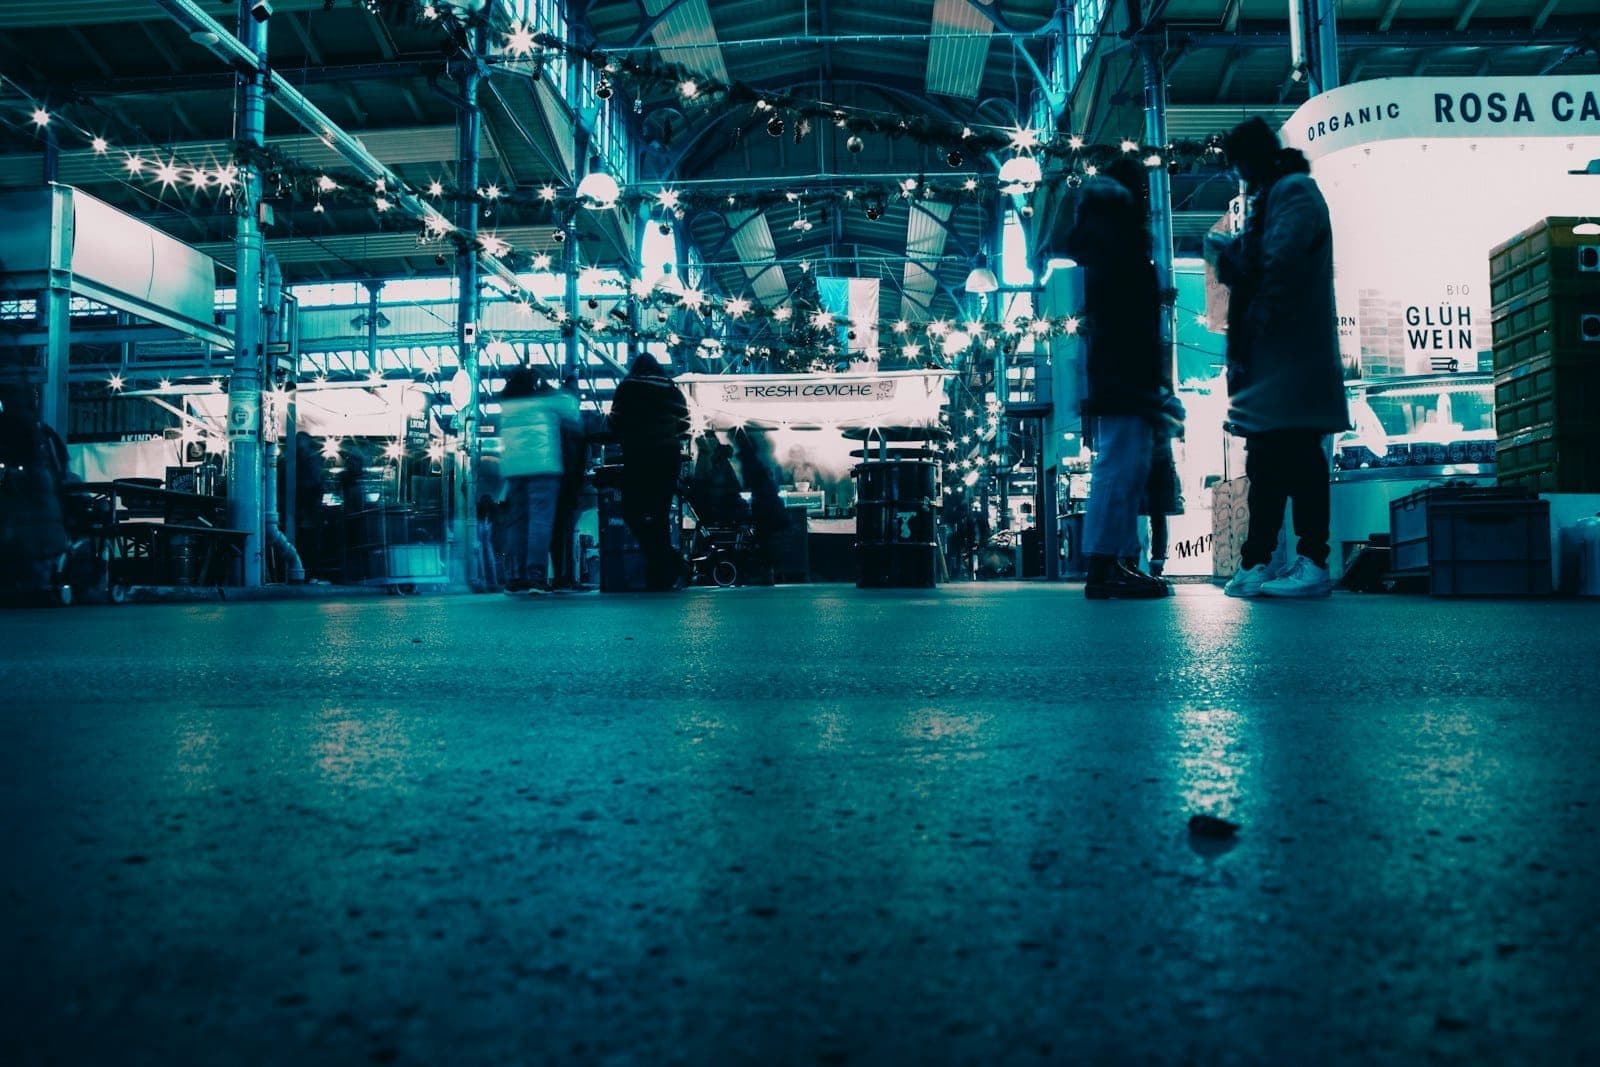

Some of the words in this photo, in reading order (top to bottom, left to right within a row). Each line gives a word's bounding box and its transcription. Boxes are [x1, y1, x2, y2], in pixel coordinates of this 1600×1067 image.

[1308, 103, 1400, 141] ORGANIC
[1434, 93, 1535, 123] ROSA
[1446, 284, 1470, 296] BIO
[1406, 301, 1472, 326] GLÜH
[1407, 329, 1473, 349] WEIN
[744, 385, 798, 398] FRESH
[802, 384, 873, 397] CEVICHE
